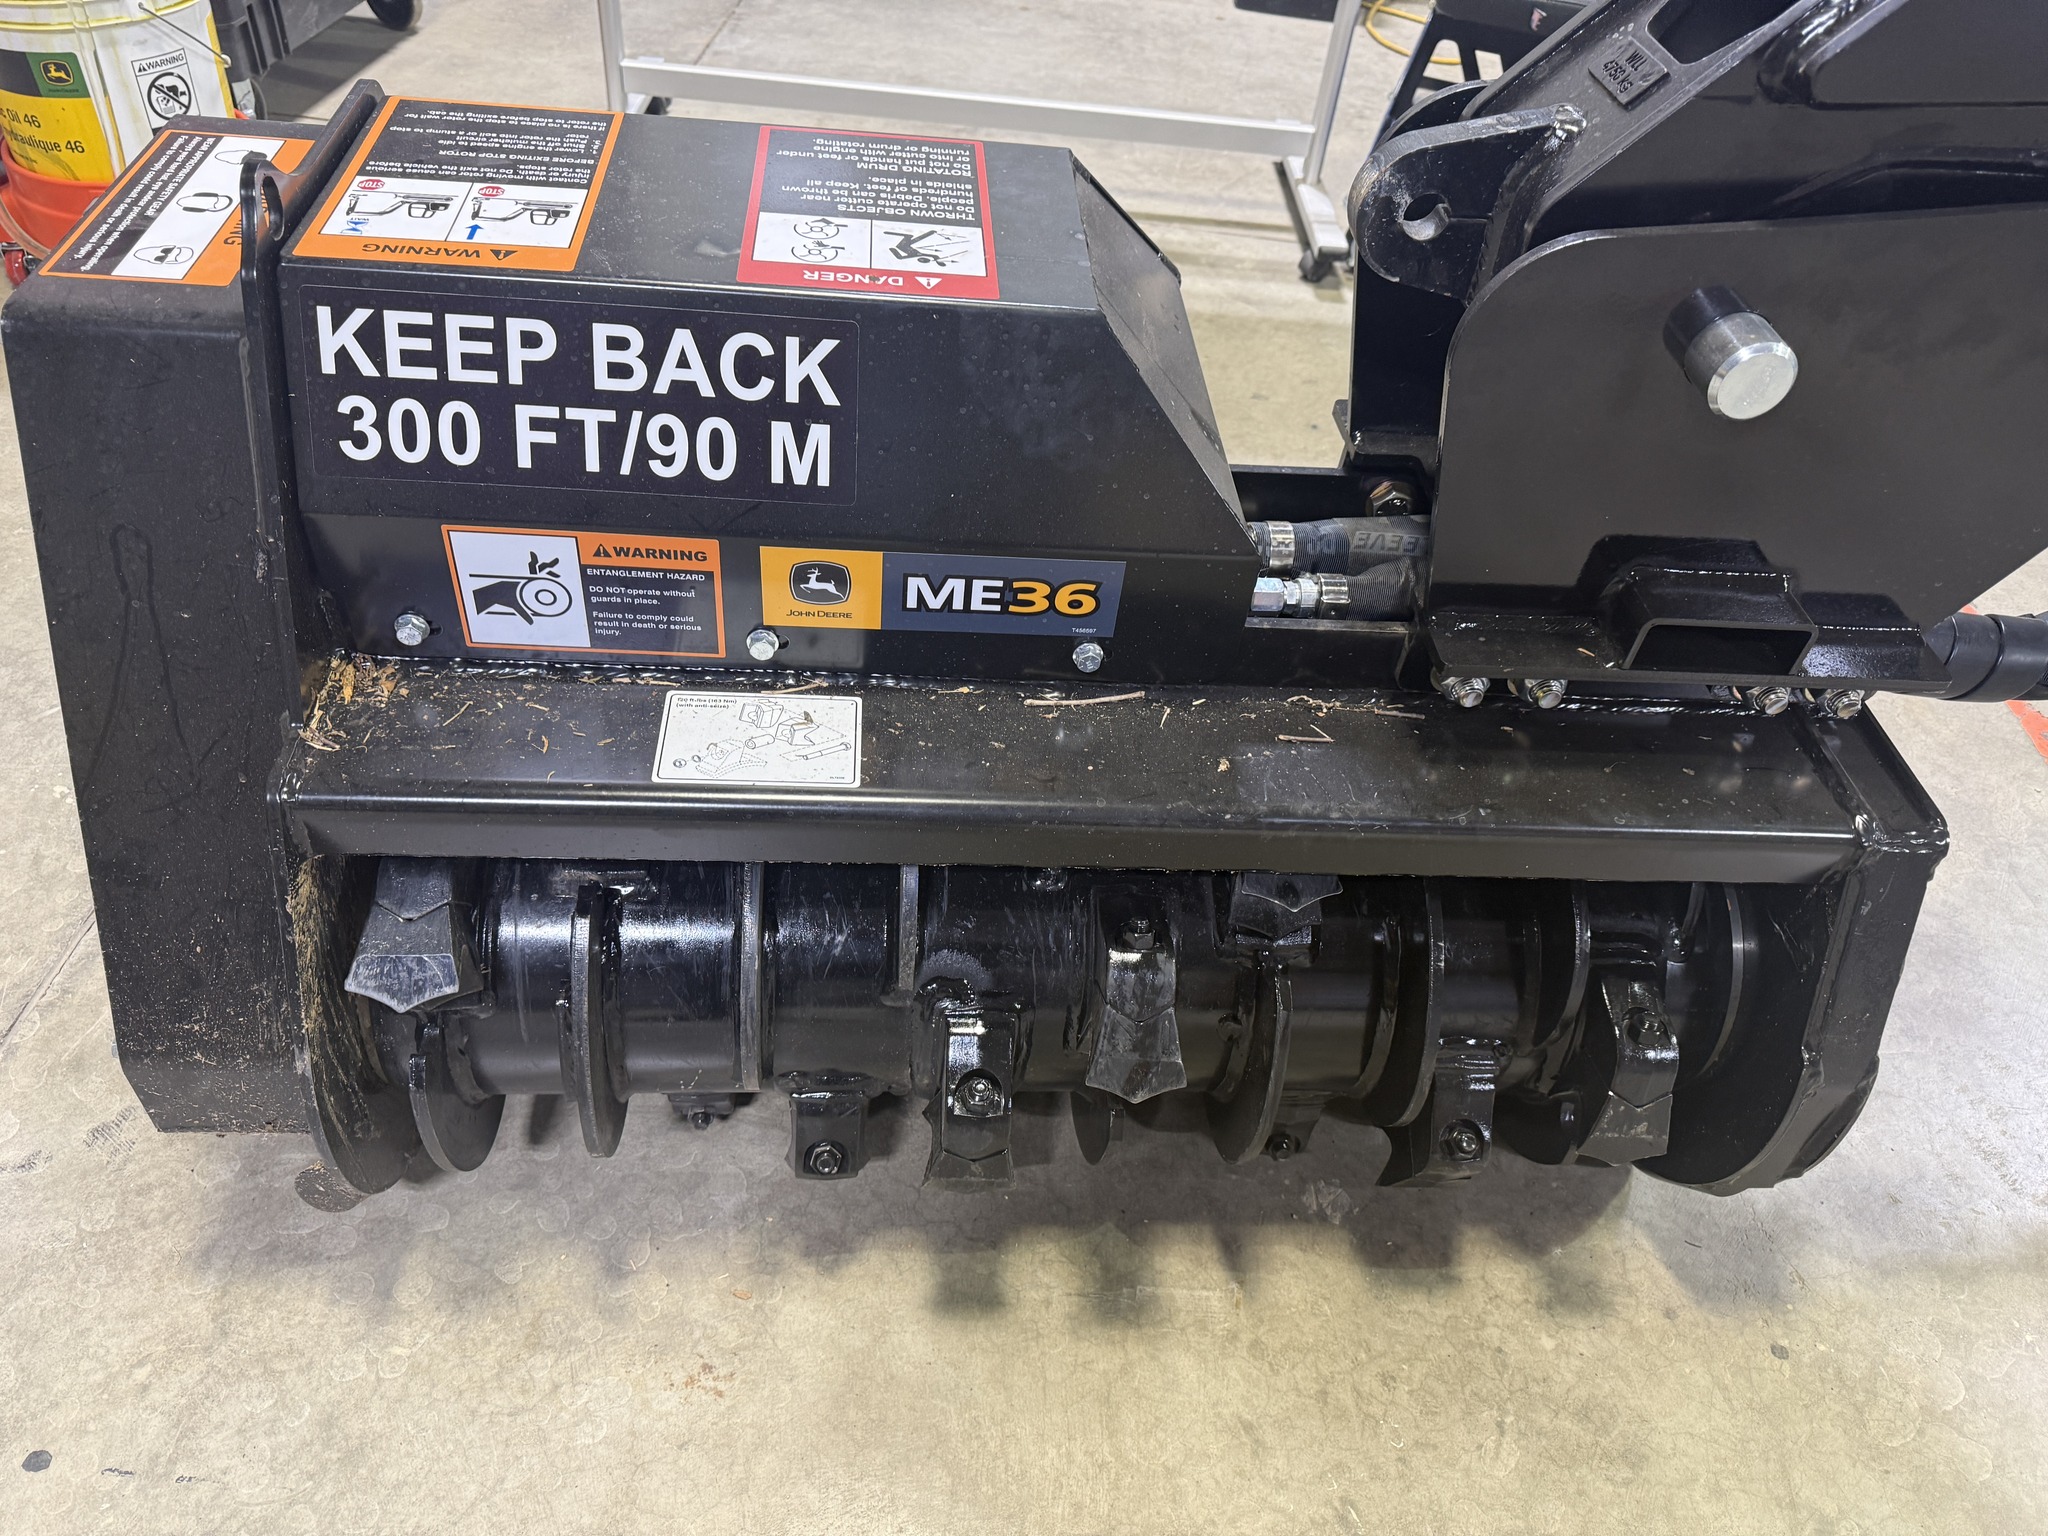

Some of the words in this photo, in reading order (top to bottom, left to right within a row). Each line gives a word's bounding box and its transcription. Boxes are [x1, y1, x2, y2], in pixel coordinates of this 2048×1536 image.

[145, 53, 185, 70] WARNING
[24, 114, 41, 128] 46
[65, 140, 85, 154] 46
[812, 138, 864, 147] rotating.
[776, 150, 814, 158] under
[813, 145, 856, 154] engine
[921, 146, 968, 155] running
[862, 156, 900, 164] hands
[889, 151, 925, 159] cutter
[856, 162, 897, 170] DRUM
[902, 165, 970, 176] ROTATING
[356, 179, 385, 188] STOP
[825, 179, 858, 189] Keep
[868, 175, 906, 185] place.
[925, 180, 971, 190] shields
[781, 185, 828, 194] thrown
[863, 183, 891, 191] feet.
[911, 187, 972, 197] hundreds
[833, 196, 873, 205] cutter
[880, 192, 922, 201] Debris
[926, 195, 973, 205] people.
[877, 199, 927, 209] operate
[837, 204, 905, 215] OBJECTS
[910, 209, 974, 220] THROWN
[359, 243, 482, 258] WARNING
[802, 269, 903, 285] DANGER
[316, 305, 557, 385] KEEP
[592, 322, 842, 407] BACK
[337, 395, 481, 467] 300
[514, 403, 737, 482] FT/90
[770, 420, 831, 487] M
[612, 546, 708, 562] WARNING
[586, 568, 664, 578] ENTANGLEMENT
[666, 572, 705, 581] HAZARD
[626, 587, 660, 596] operate
[662, 589, 695, 597] without
[905, 576, 1098, 616] ME36
[590, 594, 621, 603] guards
[634, 597, 660, 606] place.
[636, 613, 667, 621] comply
[786, 608, 816, 619] JOHN
[817, 610, 853, 620] DEERE
